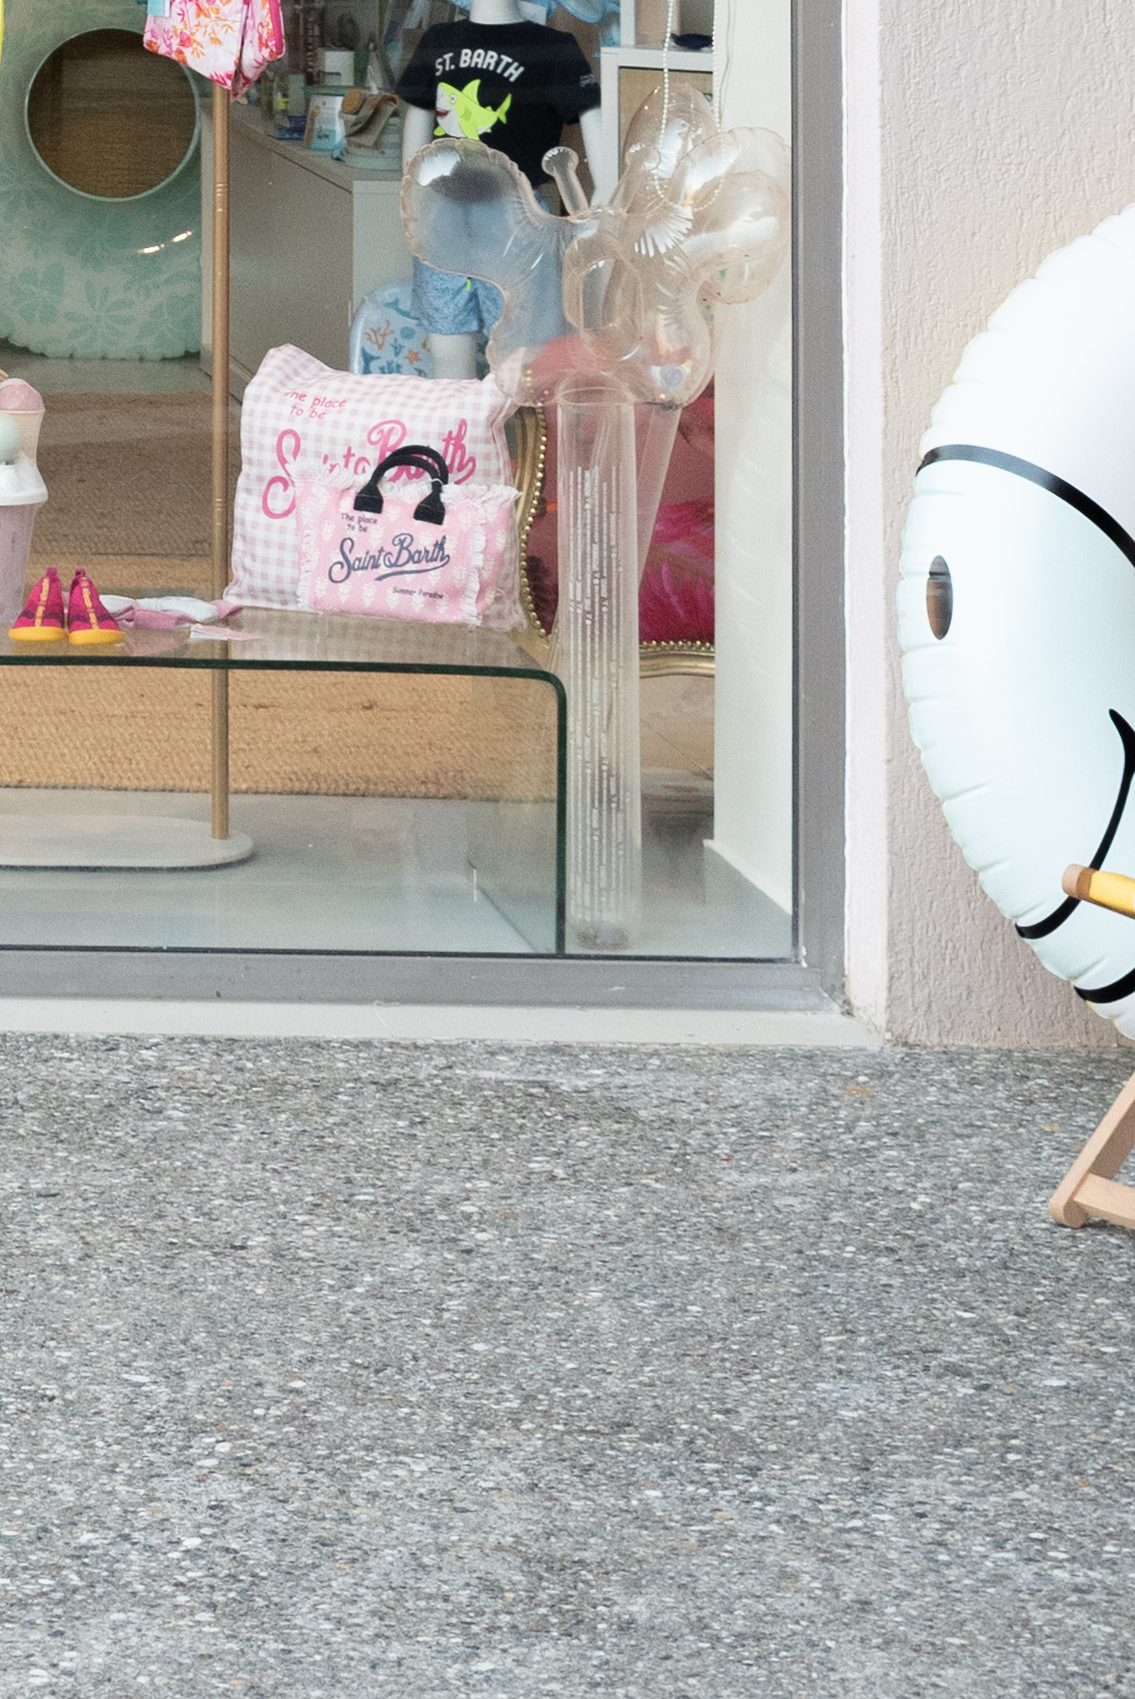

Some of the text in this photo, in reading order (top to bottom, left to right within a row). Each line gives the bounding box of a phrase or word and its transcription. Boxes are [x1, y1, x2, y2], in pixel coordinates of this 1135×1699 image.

[435, 48, 525, 83] ST. BARTH
[310, 396, 347, 409] place
[290, 403, 326, 420] to be
[340, 512, 378, 525] The place
[328, 532, 450, 584] Saint Barth
